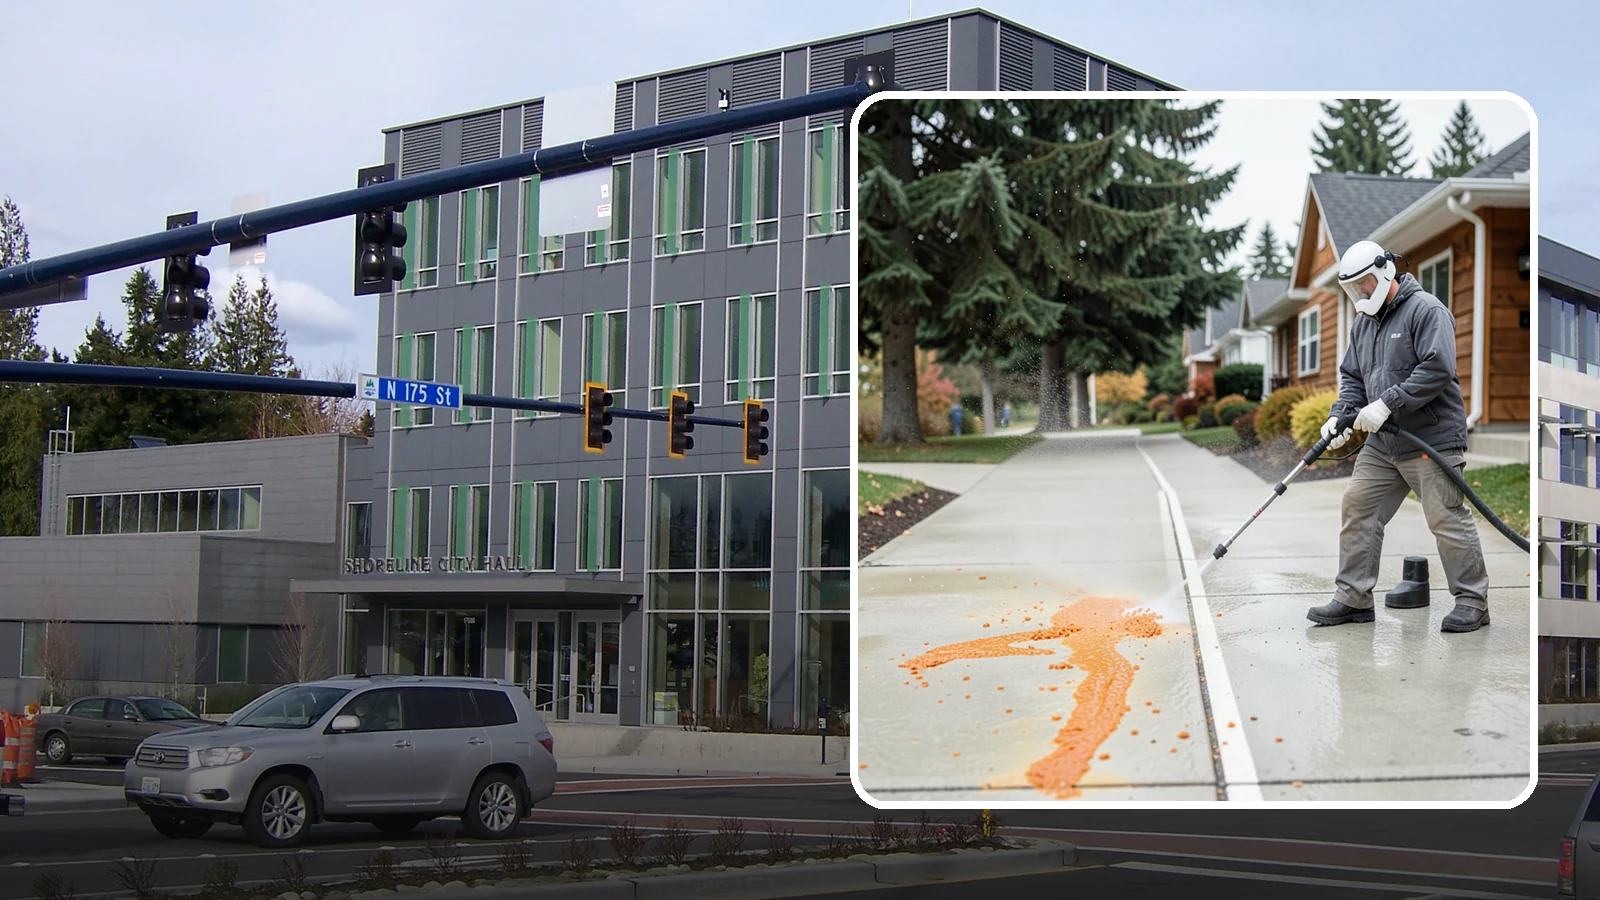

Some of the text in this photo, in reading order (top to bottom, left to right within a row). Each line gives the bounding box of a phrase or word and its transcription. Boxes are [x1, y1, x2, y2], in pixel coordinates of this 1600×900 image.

[387, 380, 451, 406] N 175 St
[345, 555, 525, 574] SHORELINE CITY HALL
